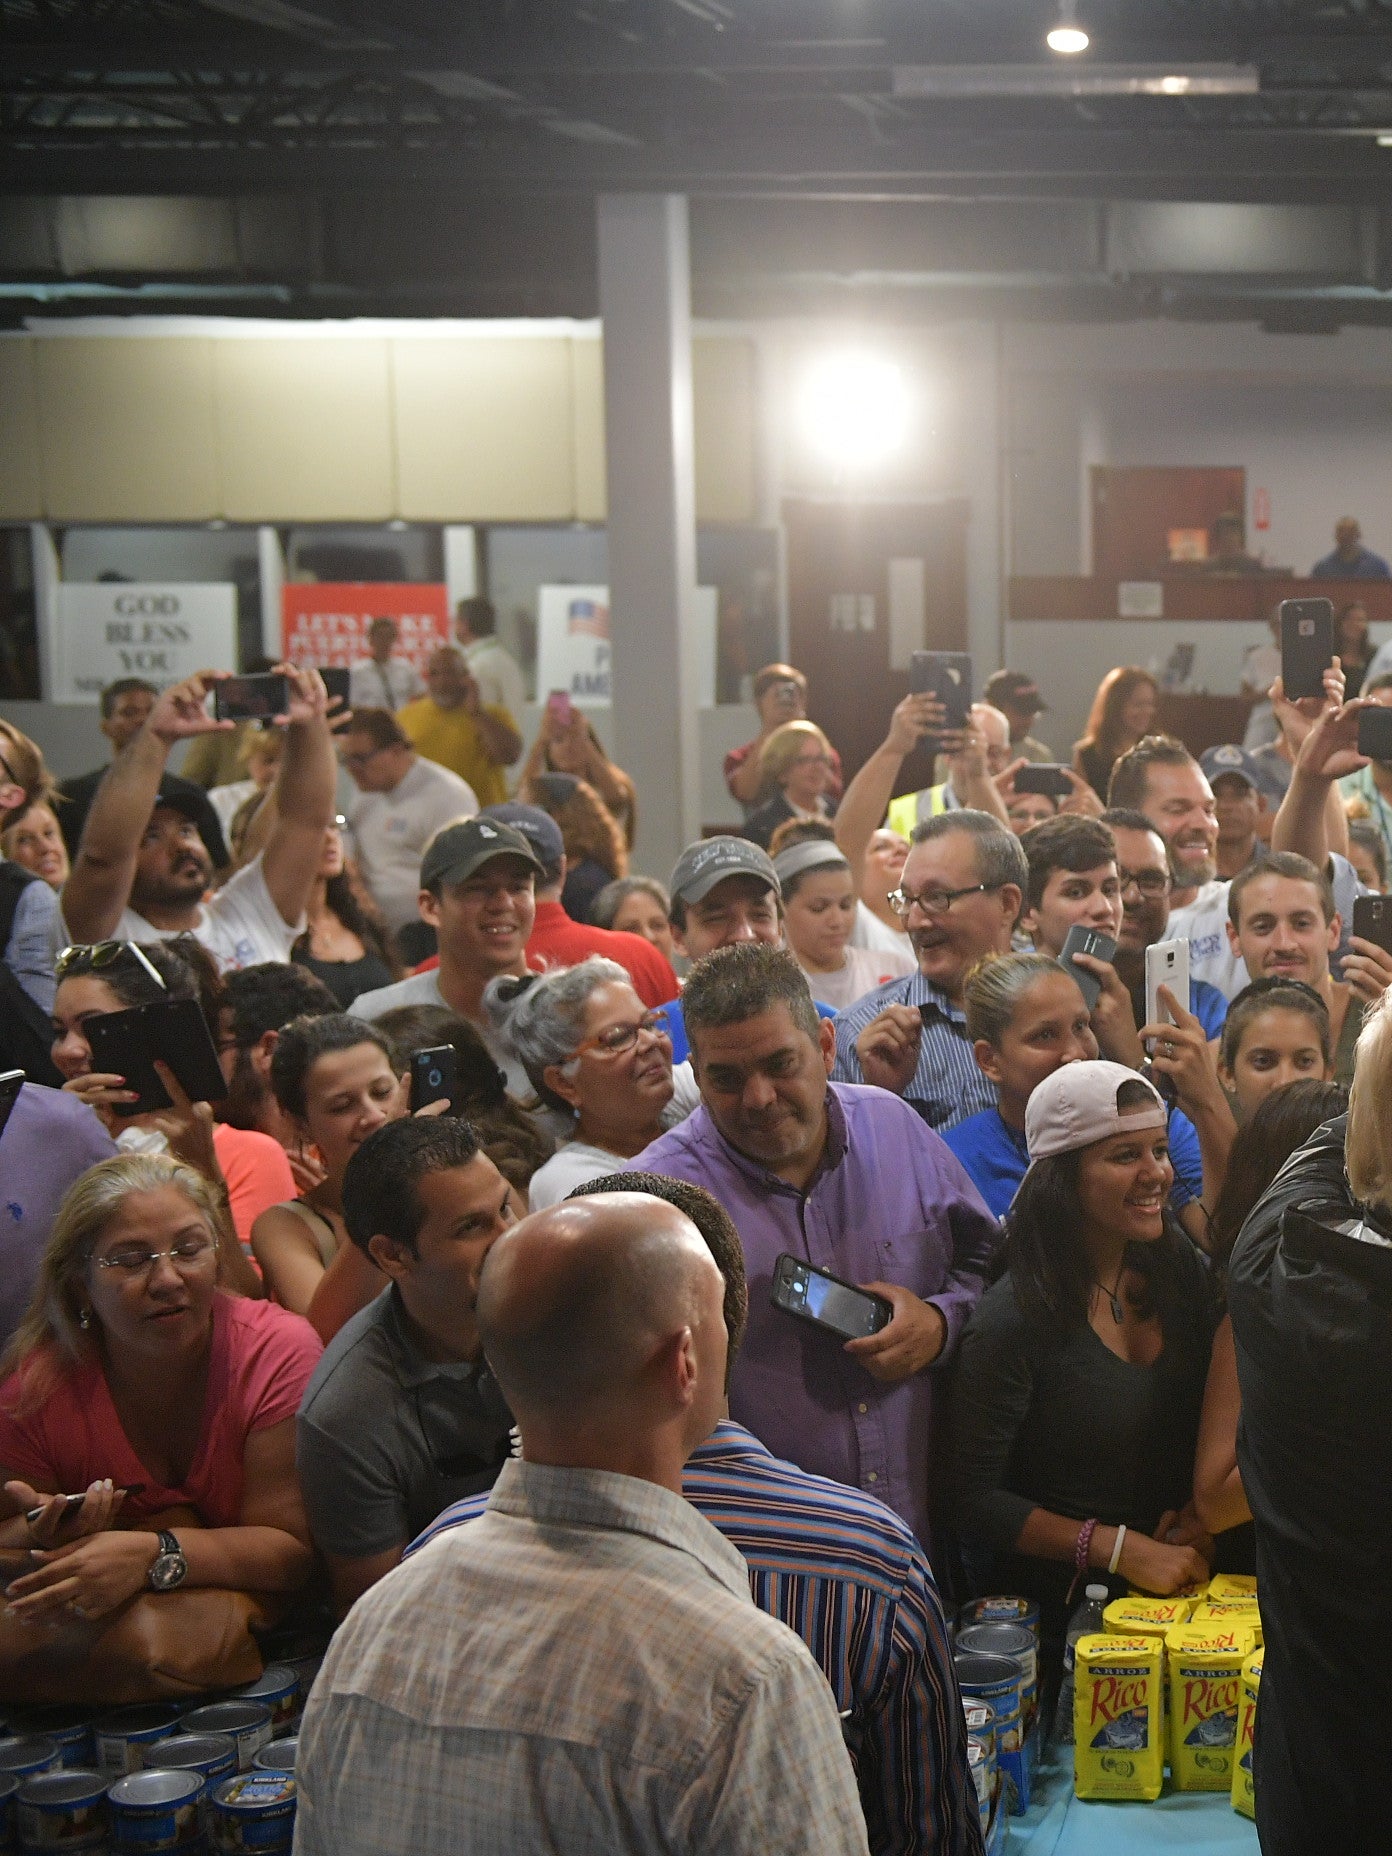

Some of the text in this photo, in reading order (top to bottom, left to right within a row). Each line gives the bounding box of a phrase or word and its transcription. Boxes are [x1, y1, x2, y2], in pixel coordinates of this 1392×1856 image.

[113, 593, 181, 616] GOD
[105, 621, 191, 644] BLESS
[118, 649, 171, 672] YOU
[1090, 1677, 1148, 1727] Rico
[1183, 1679, 1239, 1726] Rico
